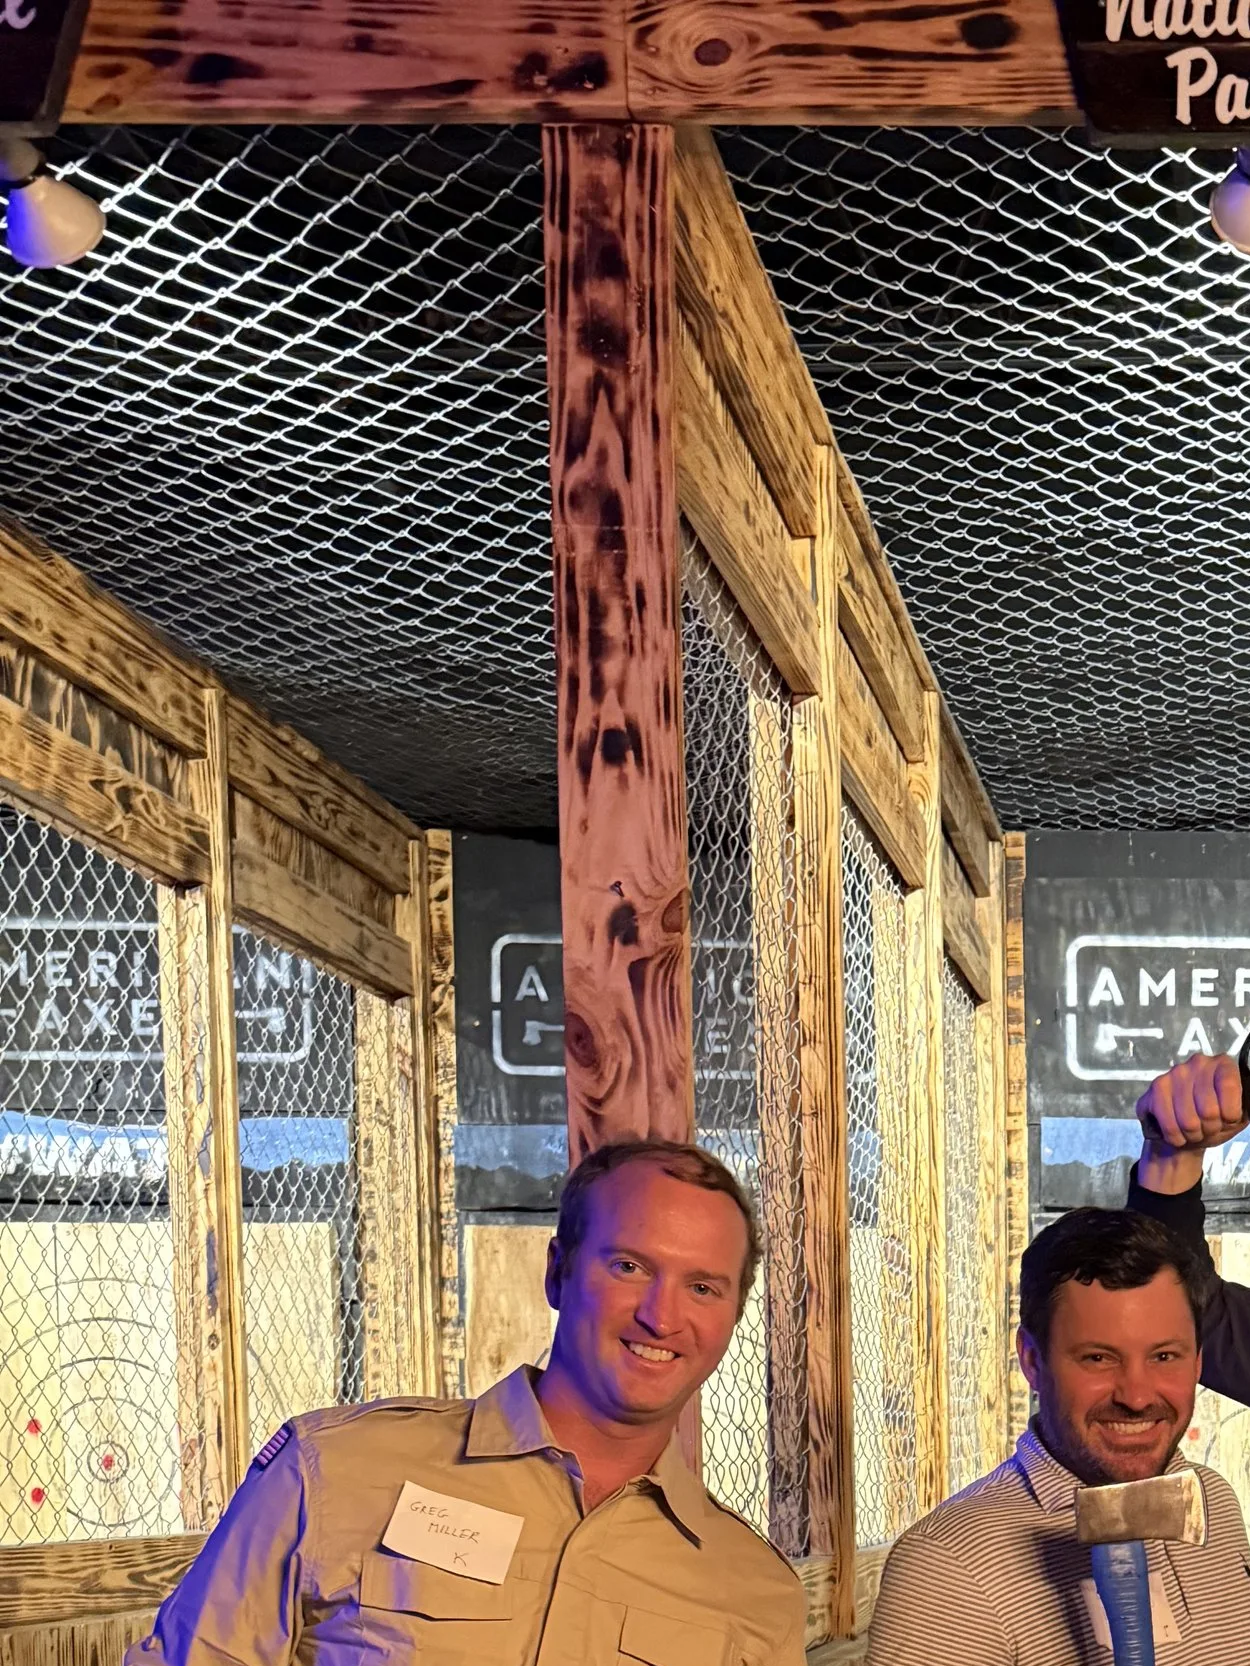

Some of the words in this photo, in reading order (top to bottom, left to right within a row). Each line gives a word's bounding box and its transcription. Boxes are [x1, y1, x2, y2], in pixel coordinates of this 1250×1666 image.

[35, 998, 160, 1036] AXE
[410, 1501, 449, 1518] GREG
[428, 1522, 480, 1543] MILLER
